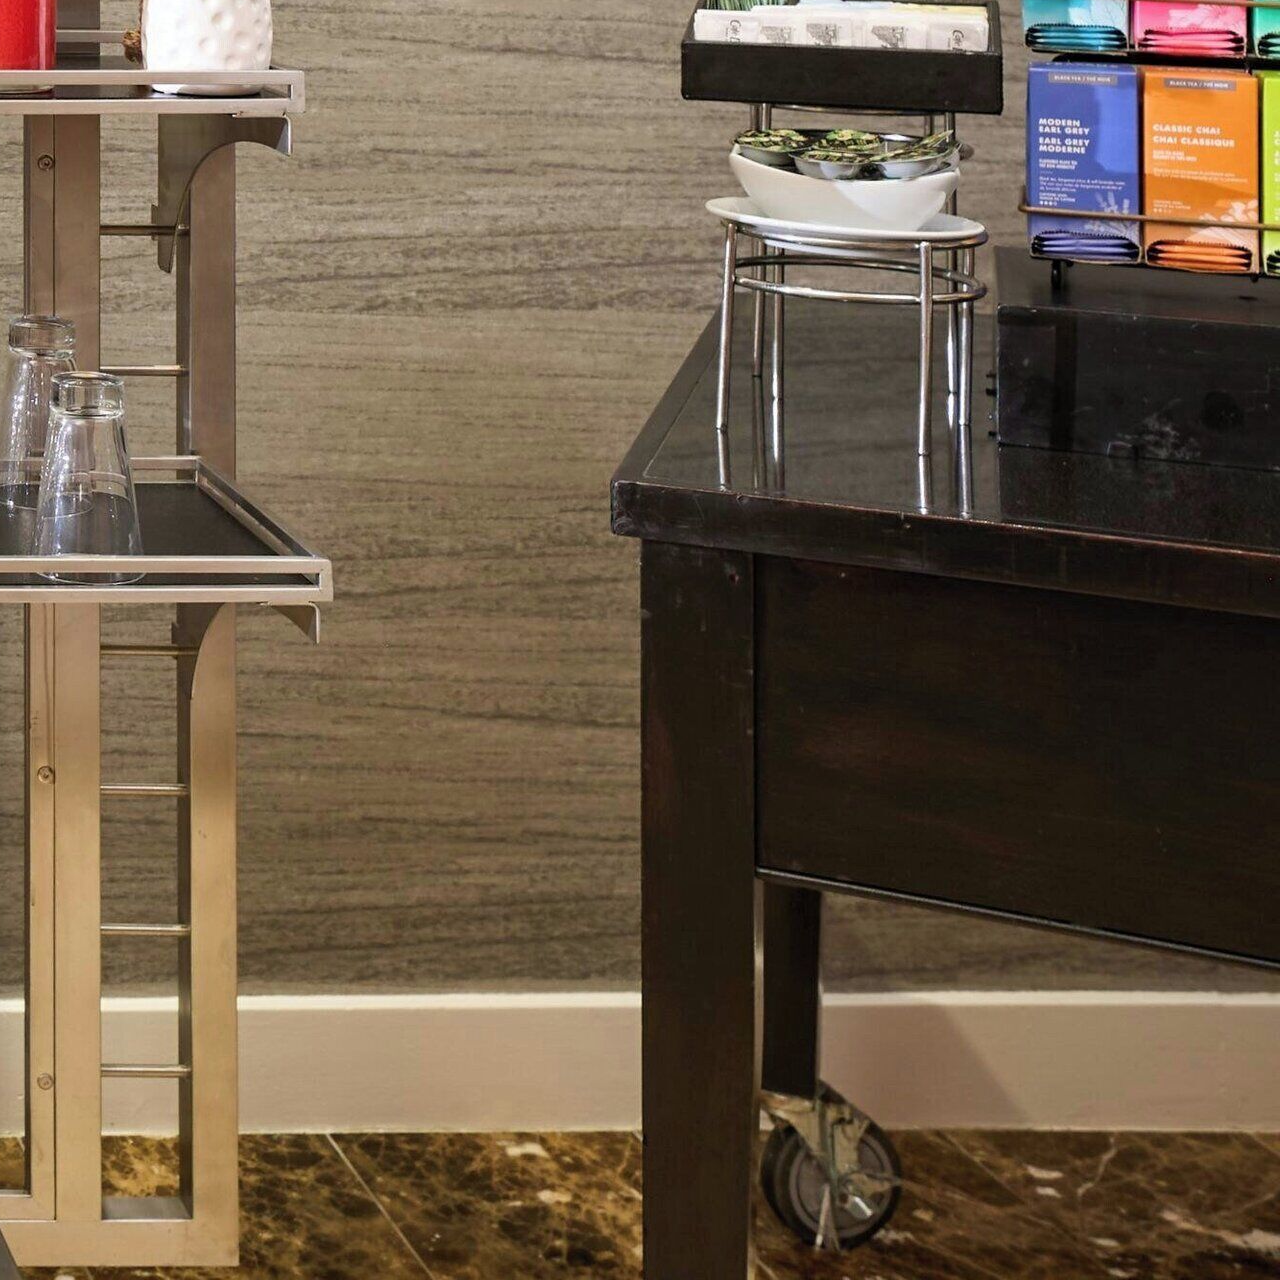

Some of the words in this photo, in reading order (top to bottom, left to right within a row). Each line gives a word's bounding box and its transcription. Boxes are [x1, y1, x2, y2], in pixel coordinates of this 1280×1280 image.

[1039, 118, 1080, 127] MODERN
[1039, 126, 1061, 134] EARL
[1065, 127, 1090, 136] GREY
[1152, 124, 1192, 134] CLASSIC
[1196, 126, 1220, 135] CHAI
[1039, 137, 1061, 145] EARL
[1065, 138, 1090, 147] GREY
[1152, 136, 1178, 144] CHAI
[1181, 137, 1235, 148] CLASSIQUE
[1039, 145, 1086, 154] MODERNE
